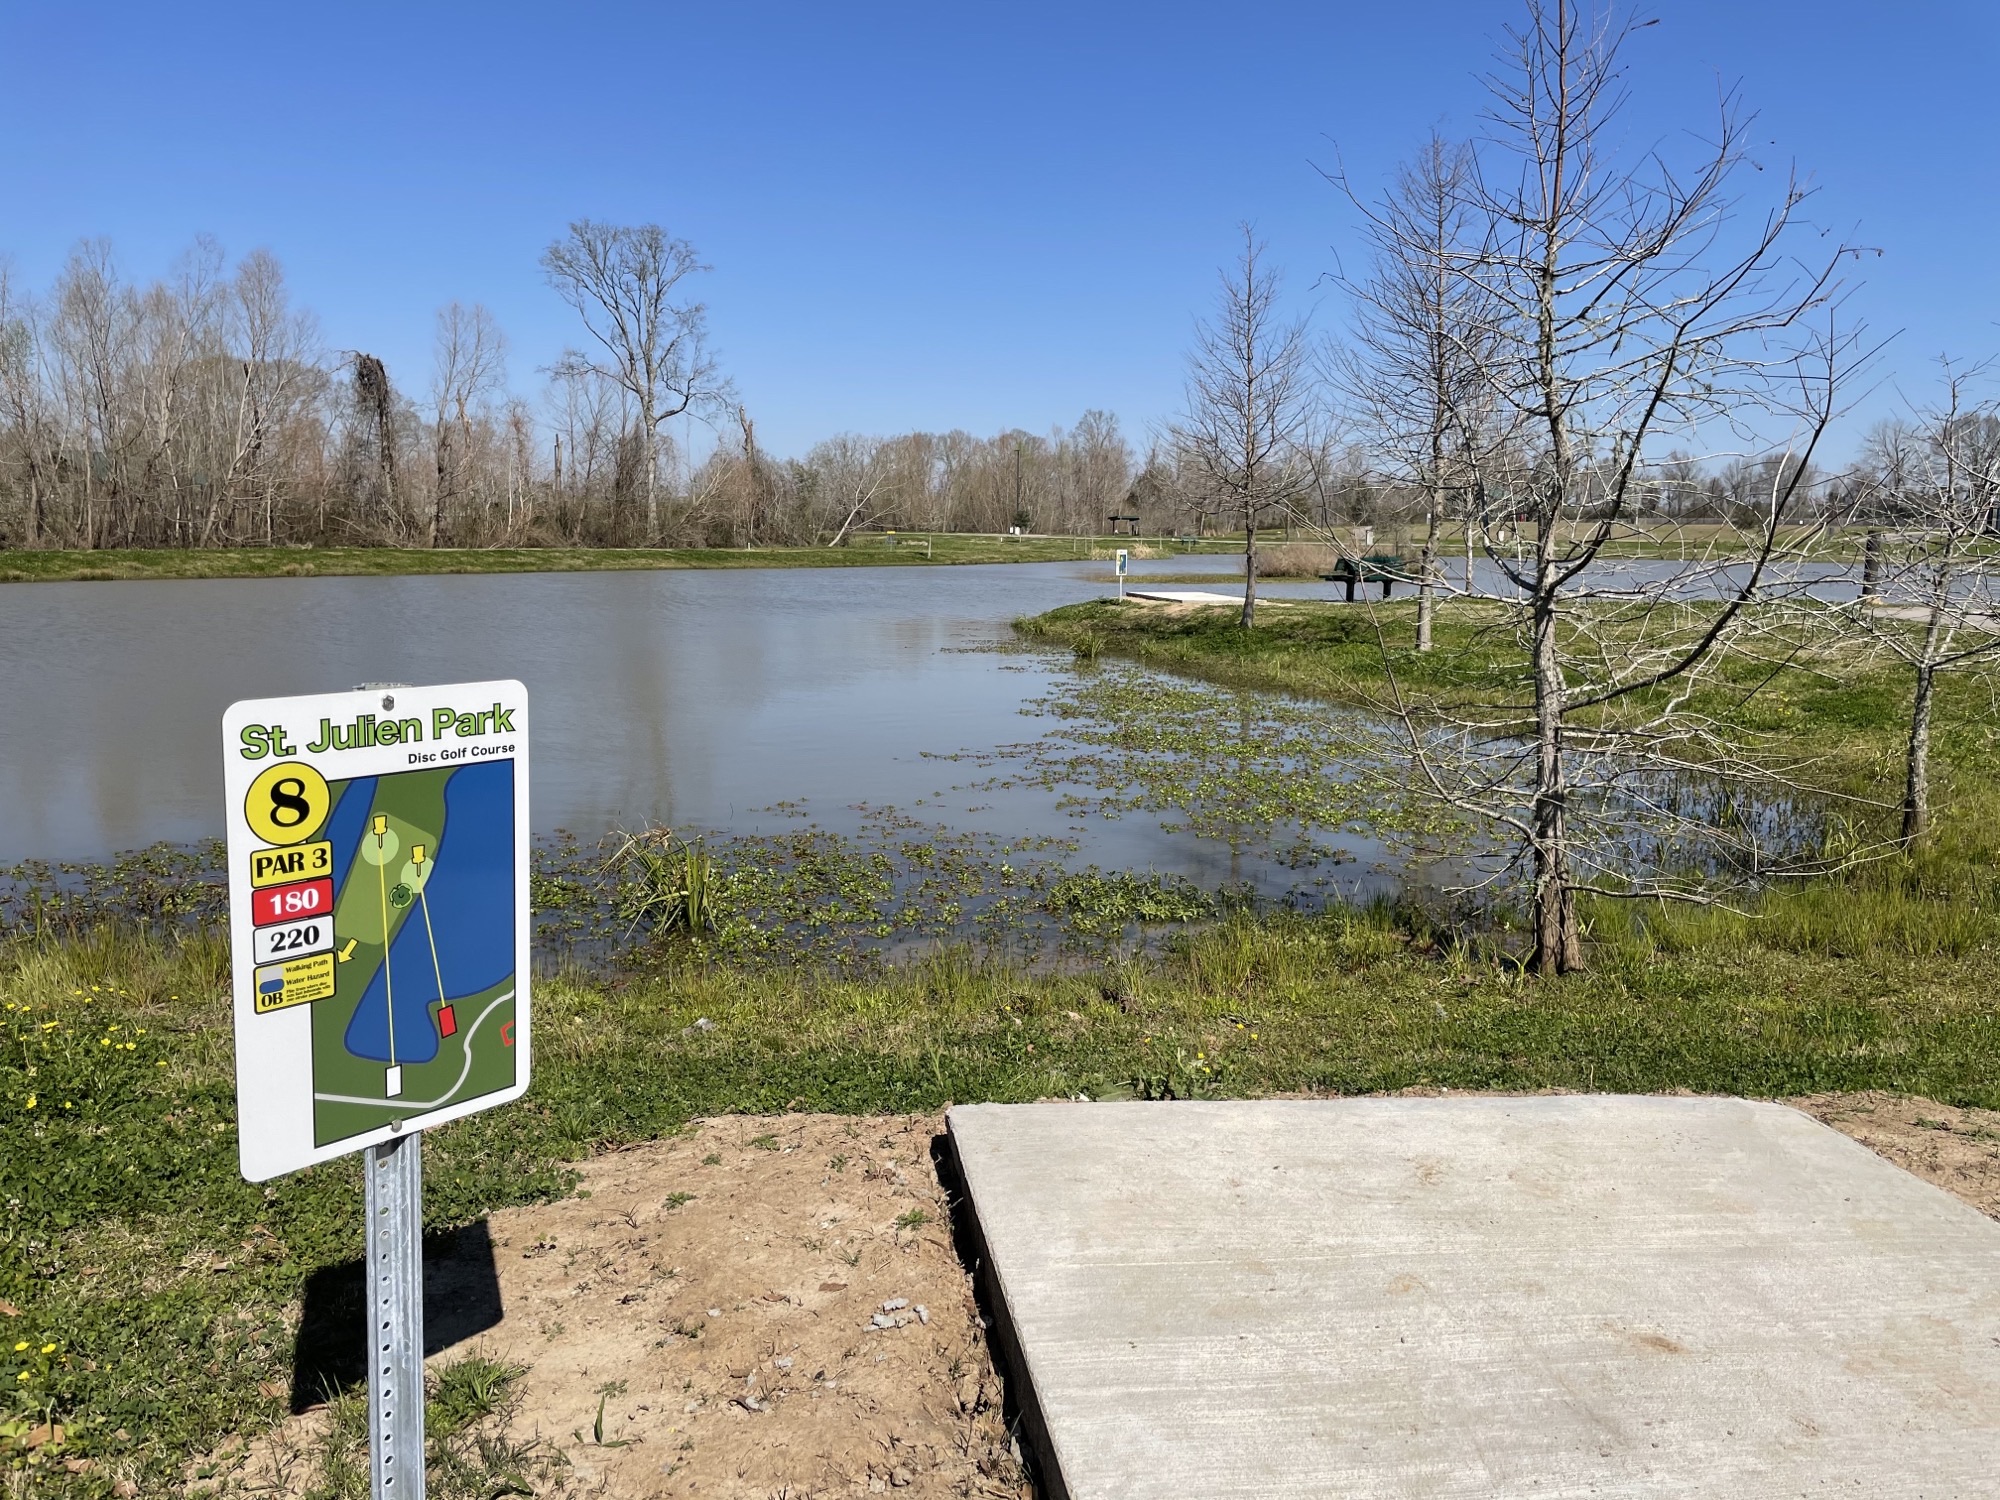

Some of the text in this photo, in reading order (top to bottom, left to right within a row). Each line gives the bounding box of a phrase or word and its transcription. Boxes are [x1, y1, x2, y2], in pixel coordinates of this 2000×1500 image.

[240, 702, 516, 760] St. Julien Park
[408, 744, 515, 764] Disc Golf Course
[270, 777, 310, 827] 8
[256, 848, 328, 878] PAR 3
[270, 888, 319, 915] 180
[270, 925, 320, 953] 220
[285, 959, 328, 973] Walking Path
[286, 971, 330, 986] Water Hazard
[261, 992, 283, 1007] OB
